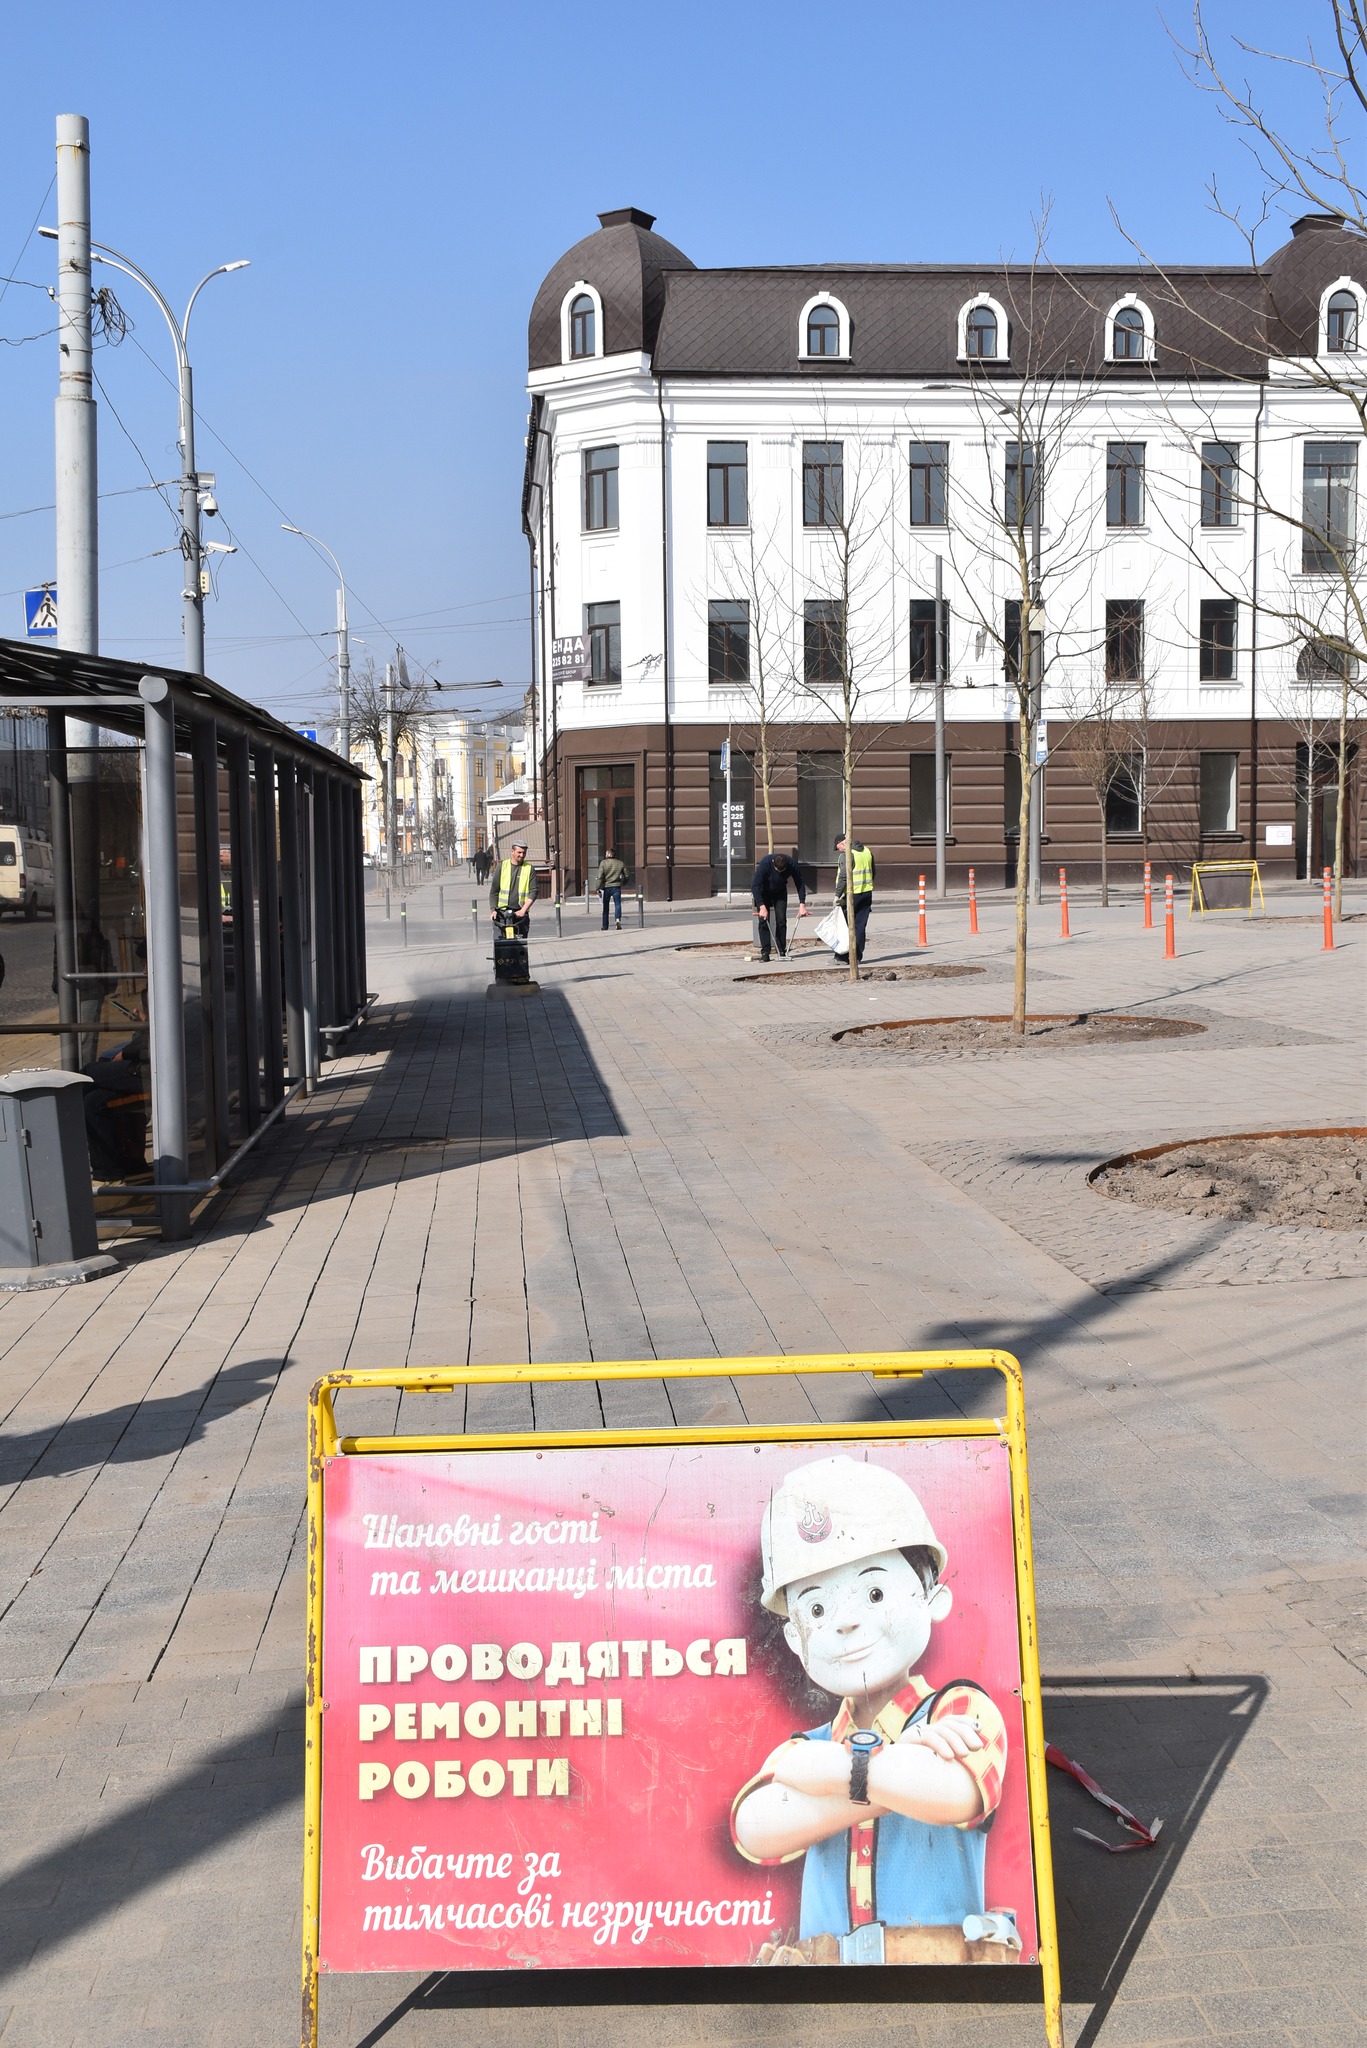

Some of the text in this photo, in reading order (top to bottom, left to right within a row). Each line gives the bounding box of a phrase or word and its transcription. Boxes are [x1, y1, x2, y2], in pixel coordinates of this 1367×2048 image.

[561, 655, 572, 665] 82
[574, 654, 584, 664] 81
[362, 1511, 602, 1549] Шановні гості
[370, 1556, 717, 1600] та мешканці міста
[358, 1638, 748, 1686] ПРОВОДЯТЬСЯ
[358, 1698, 624, 1741] РЕМОНТНІ
[358, 1757, 571, 1801] РОБОТИ
[360, 1843, 562, 1896] Вибачте за
[362, 1890, 776, 1945] тимчасові незручності
